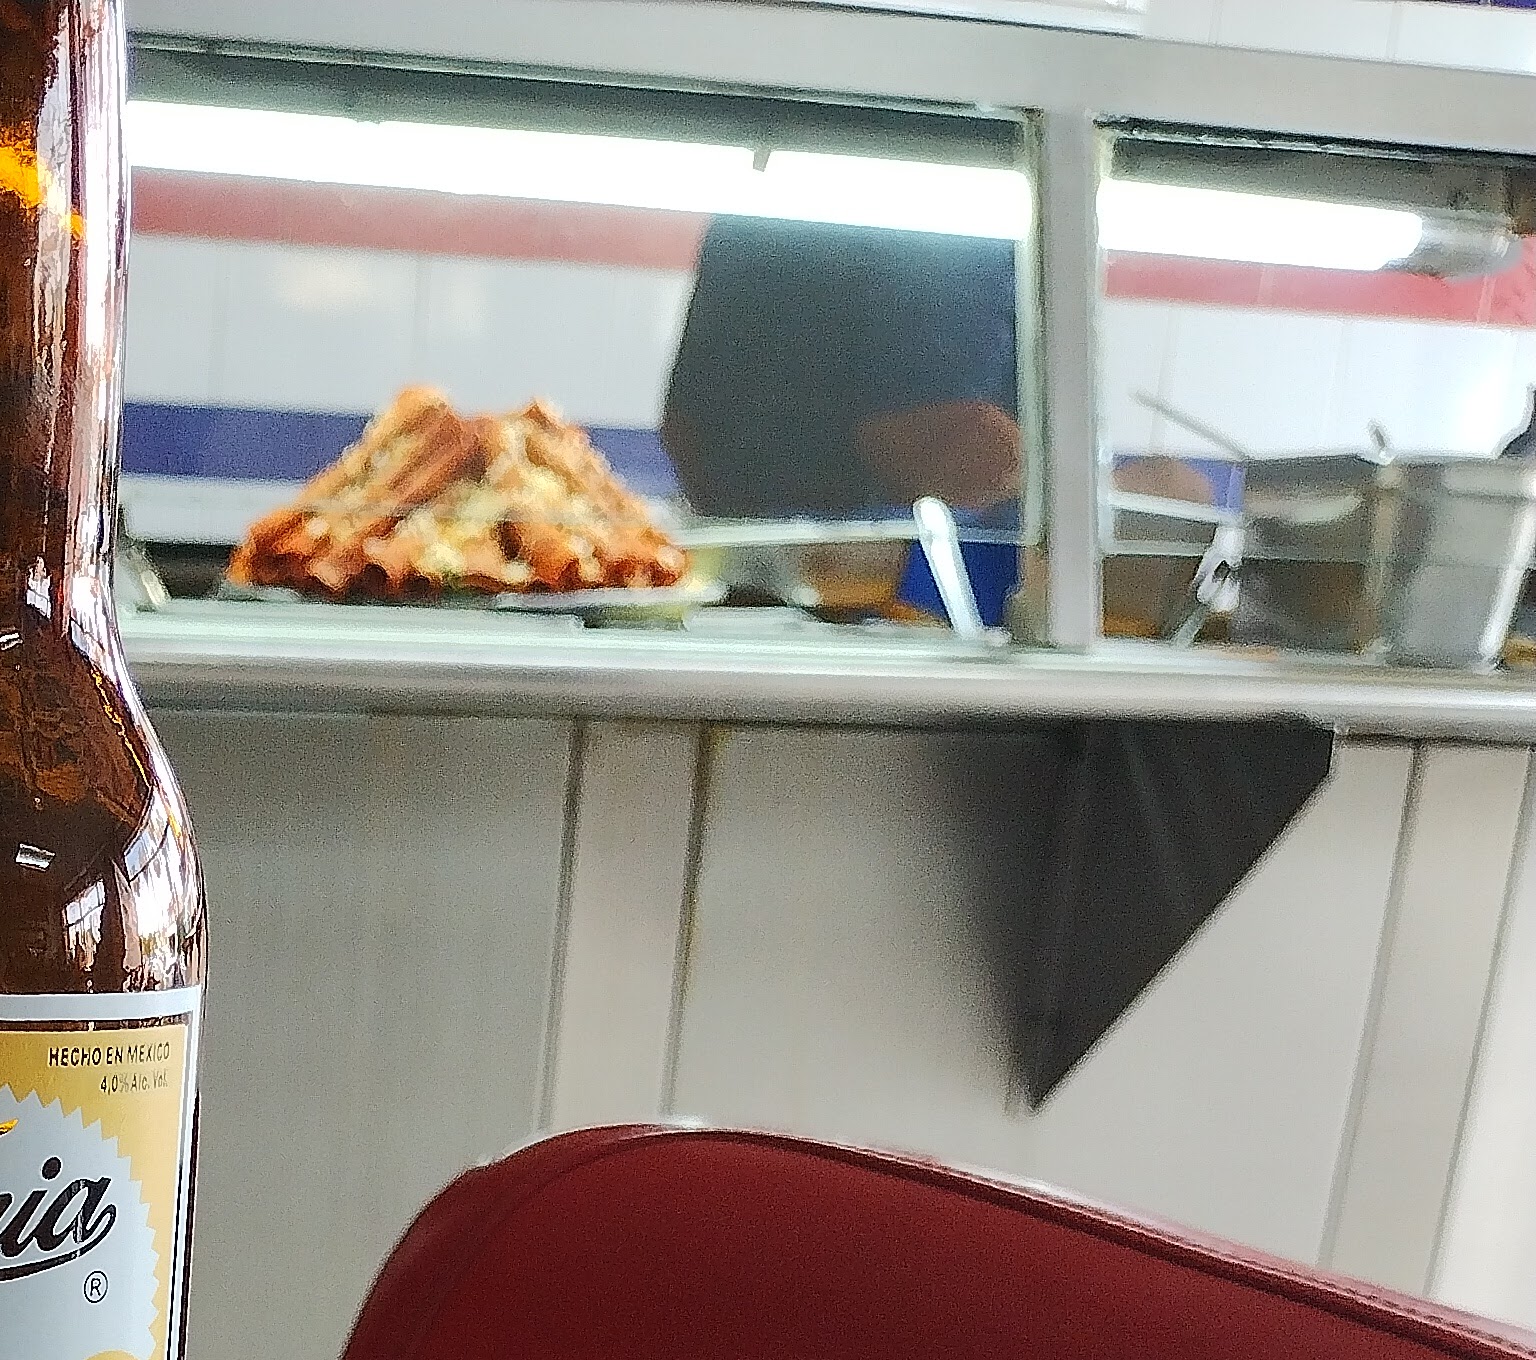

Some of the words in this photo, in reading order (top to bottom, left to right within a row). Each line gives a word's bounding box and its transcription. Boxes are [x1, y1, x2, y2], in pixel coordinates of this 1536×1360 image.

[48, 1046, 102, 1067] HECHO
[105, 1046, 124, 1065] EN
[126, 1041, 170, 1064] MEXICO
